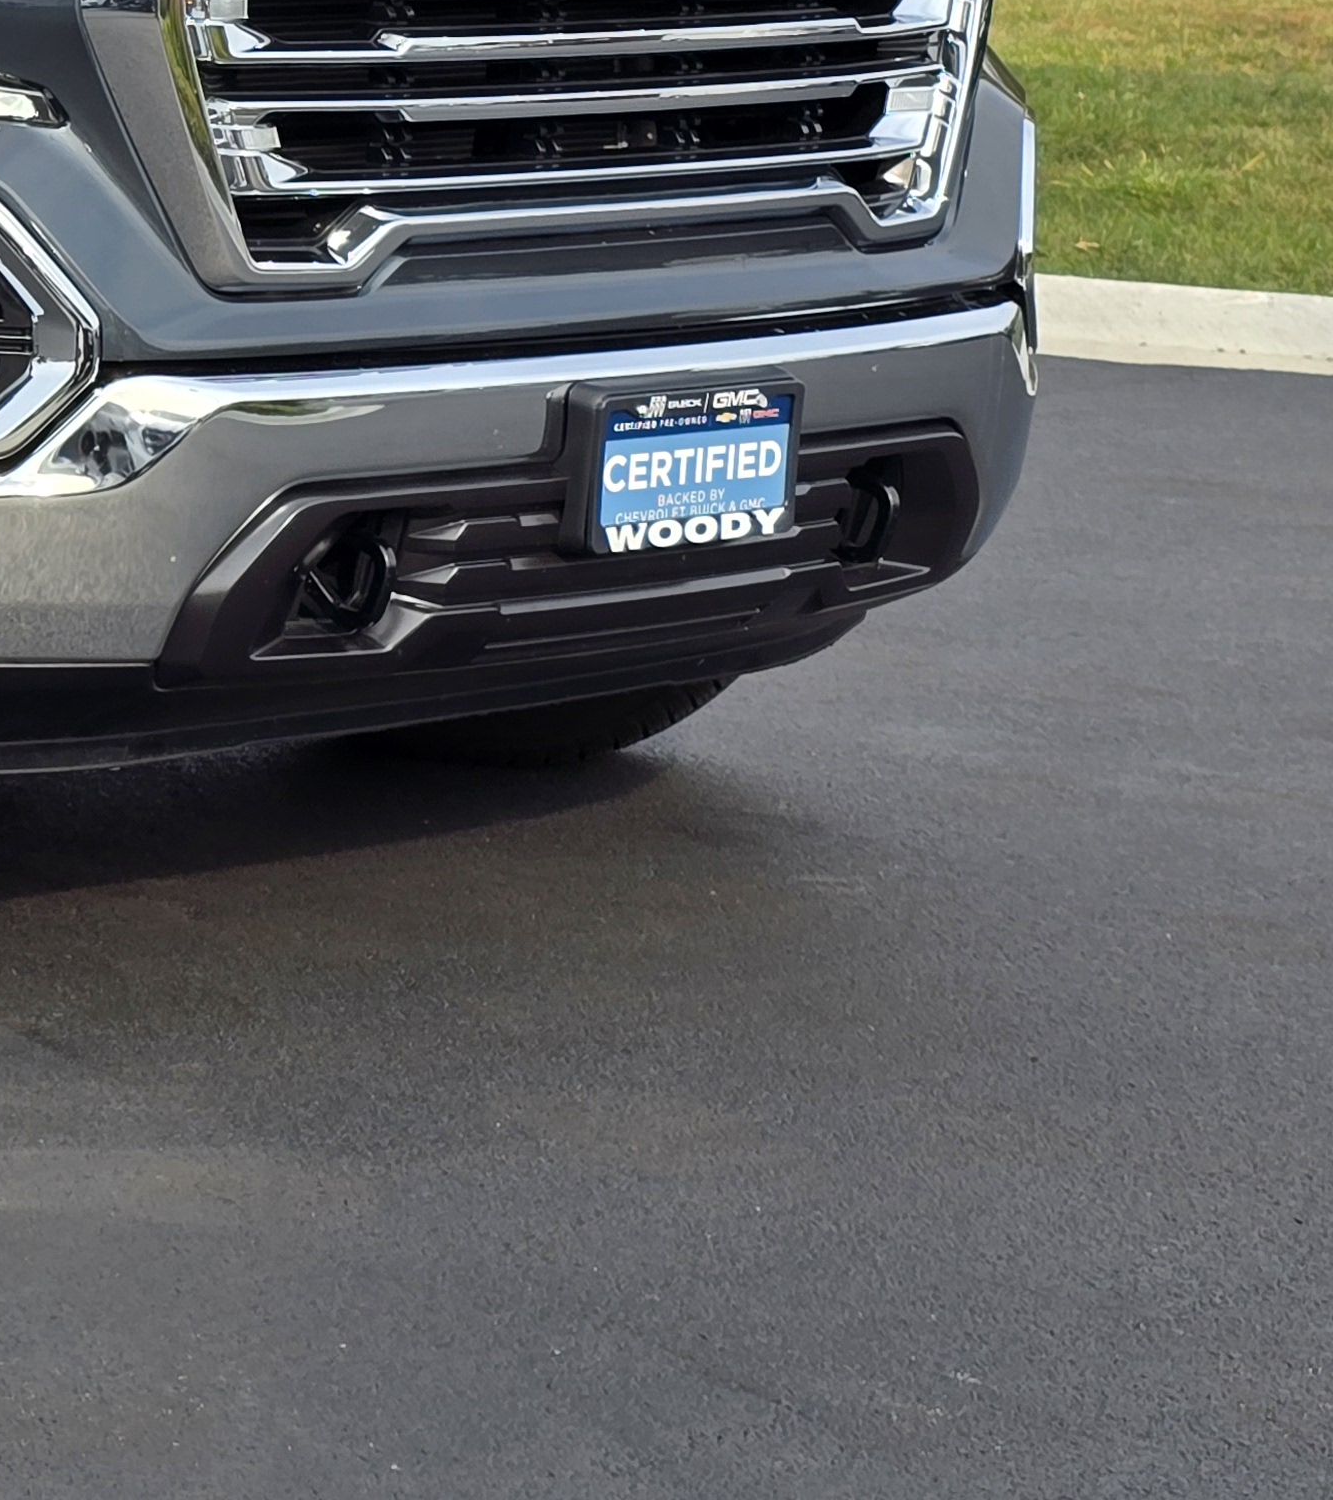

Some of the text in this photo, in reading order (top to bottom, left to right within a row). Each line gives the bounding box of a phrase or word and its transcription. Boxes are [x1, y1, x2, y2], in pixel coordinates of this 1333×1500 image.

[713, 389, 761, 409] GMC
[603, 440, 782, 492] CERTIFIED
[658, 488, 726, 507] BACKED BY
[604, 507, 785, 553] WOODY
